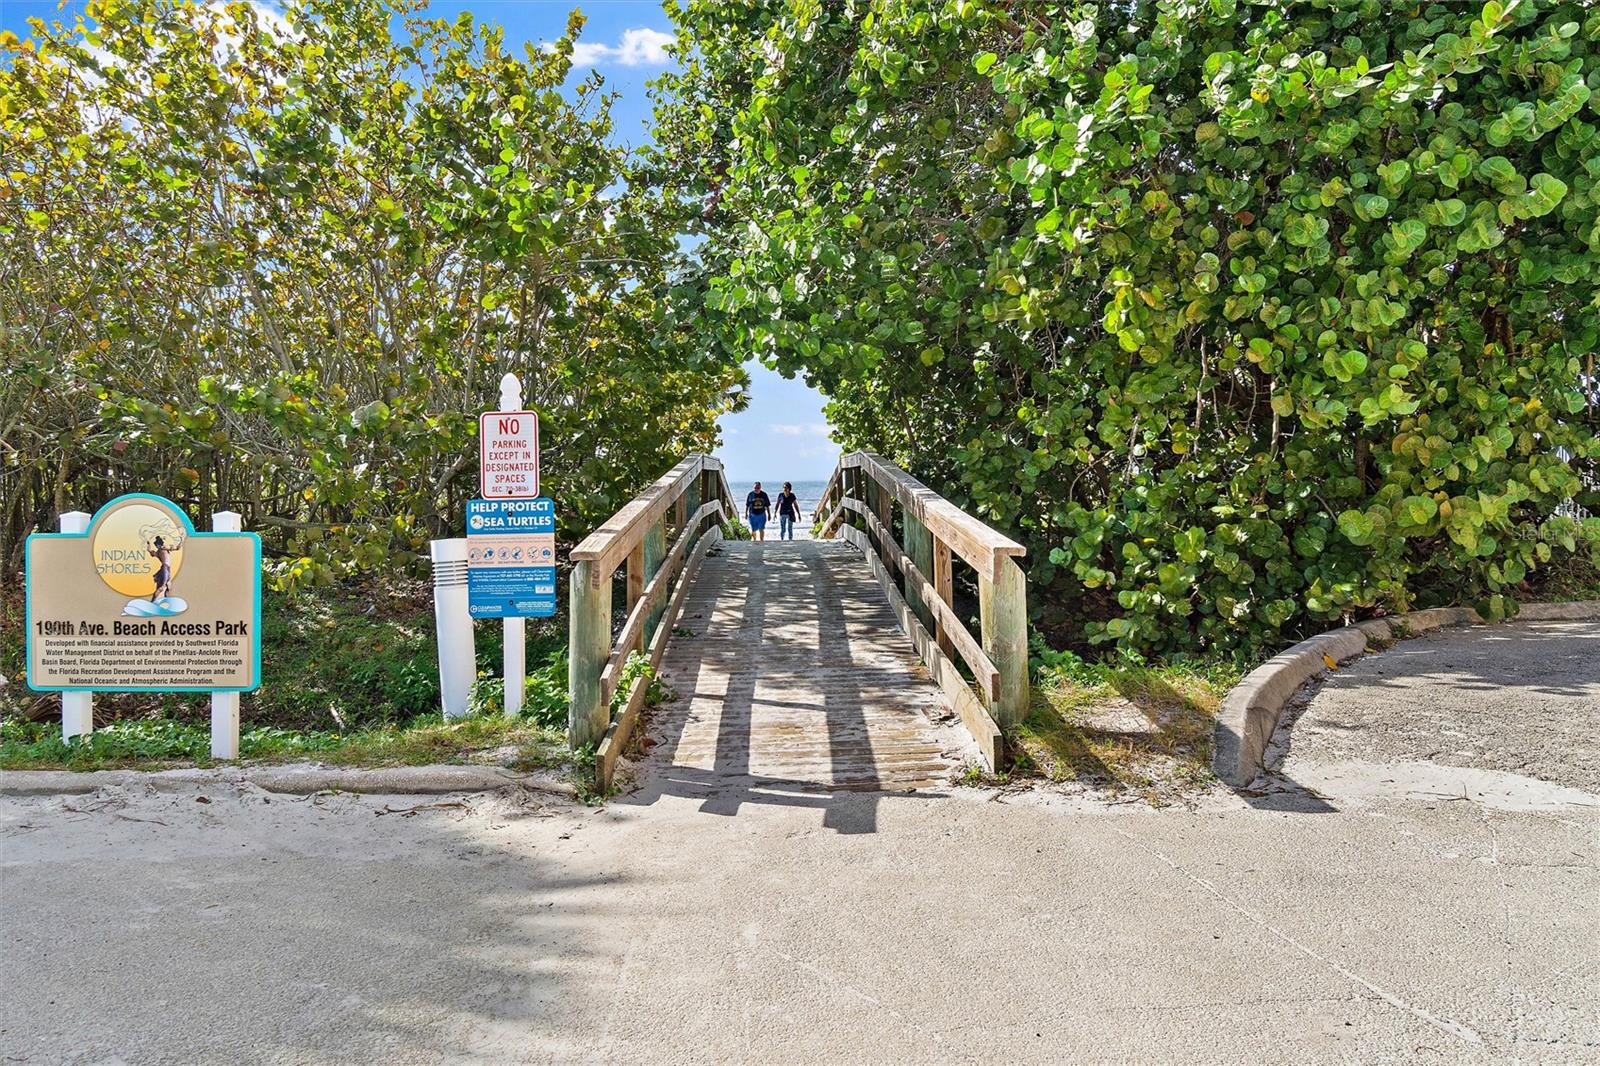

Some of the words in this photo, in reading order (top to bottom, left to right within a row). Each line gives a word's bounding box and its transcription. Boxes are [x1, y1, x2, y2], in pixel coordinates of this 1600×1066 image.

[499, 419, 520, 435] NO
[492, 440, 527, 449] PARKING
[489, 452, 519, 460] EXCEPT
[486, 463, 534, 472] DESIGNATED
[495, 475, 526, 483] SPACES
[471, 502, 498, 512] HELP
[501, 501, 549, 511] PROTECT
[484, 517, 505, 527] SEA
[507, 516, 552, 526] TURTLES
[101, 550, 146, 561] INDIAN
[96, 563, 150, 575] SHORES
[79, 621, 108, 635] Ave.
[114, 621, 155, 635] Beach
[161, 621, 210, 635] Access
[216, 621, 247, 635] Park
[65, 649, 102, 657] Management
[114, 668, 152, 676] Development
[186, 668, 212, 676] Program
